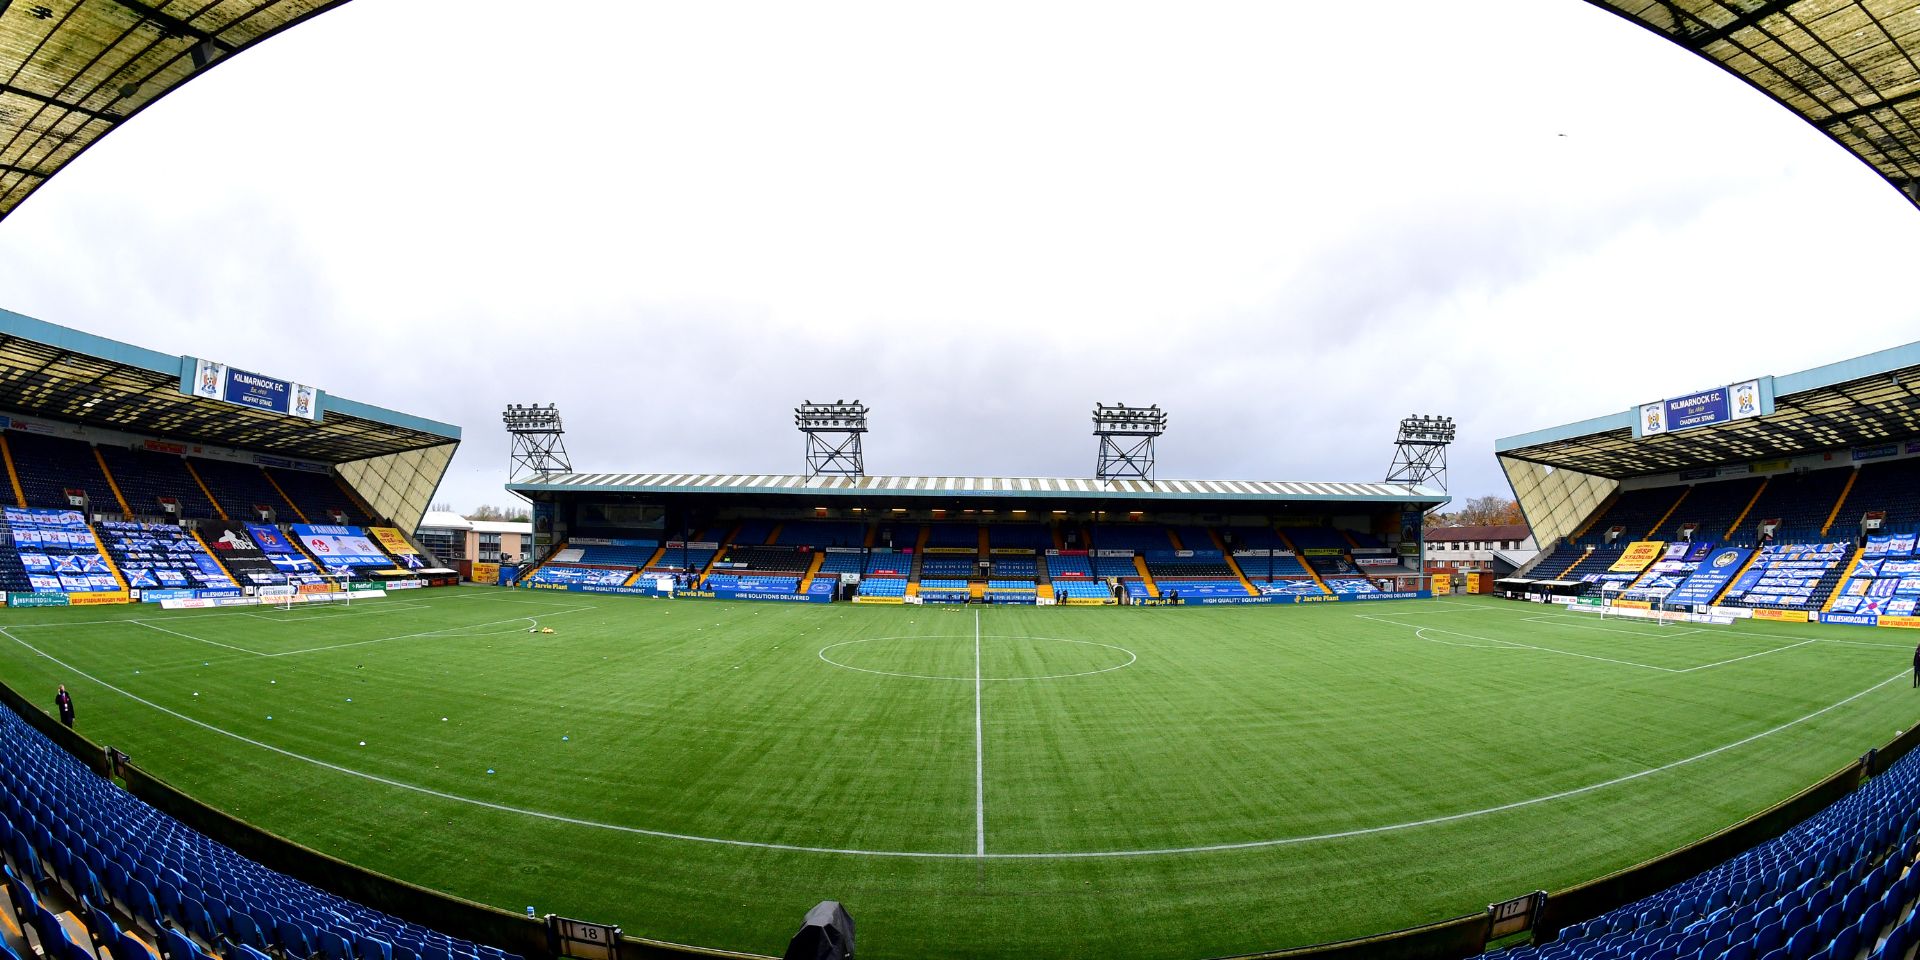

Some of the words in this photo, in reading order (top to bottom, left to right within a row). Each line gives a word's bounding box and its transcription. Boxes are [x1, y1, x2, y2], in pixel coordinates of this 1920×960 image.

[233, 373, 274, 390] KILMARNOCK
[274, 383, 284, 392] F.C.
[242, 395, 259, 404] MOFFAT
[259, 399, 273, 407] STAND
[1670, 395, 1710, 410] KILMARNOCK
[1710, 393, 1721, 402] F.C.
[1680, 416, 1702, 425] CHADWICK
[1701, 414, 1715, 422] STAND
[1827, 614, 1869, 624] KILLIESHOP.CO.UK
[1507, 902, 1519, 914] 17
[581, 927, 598, 939] 18
